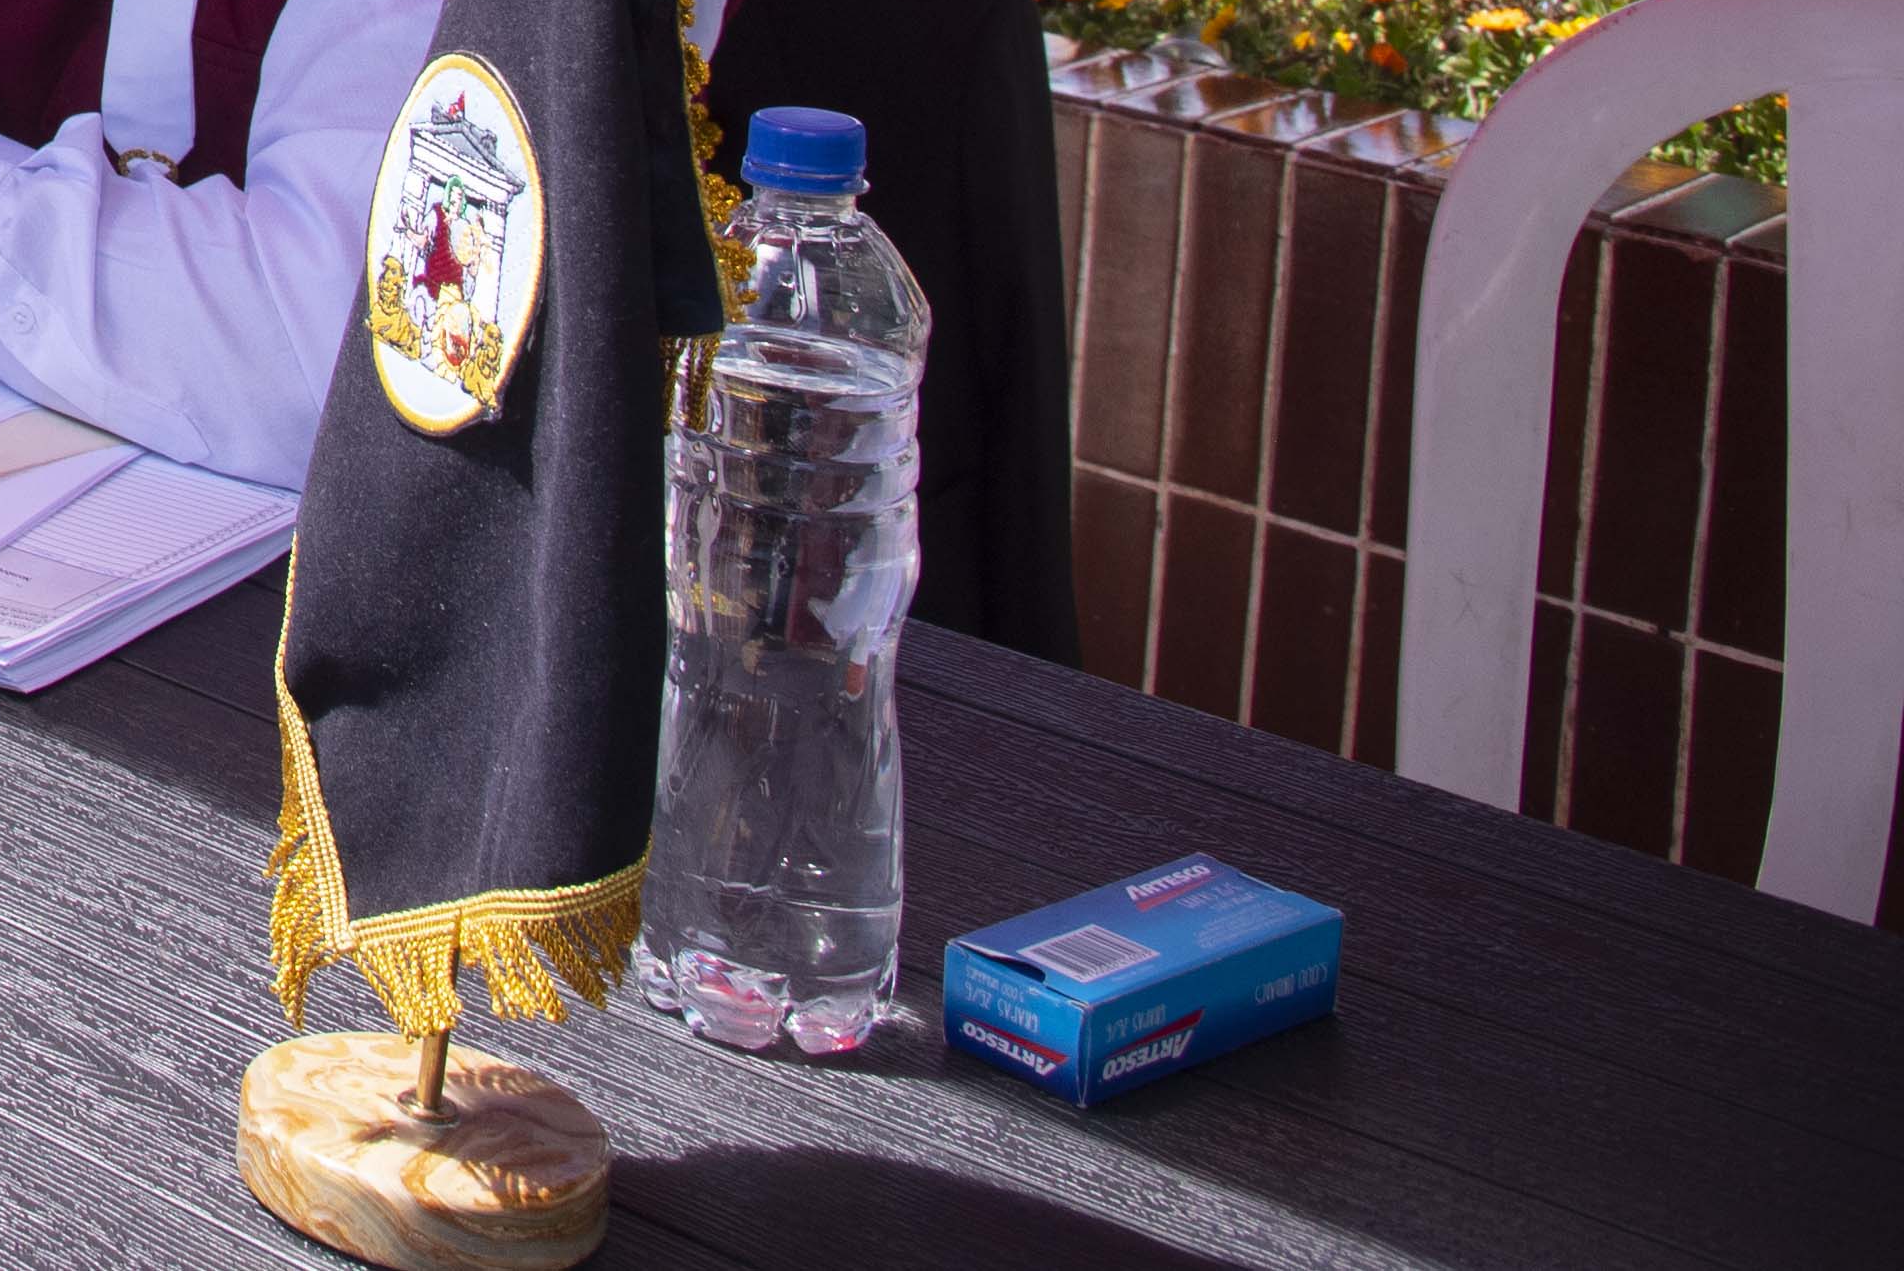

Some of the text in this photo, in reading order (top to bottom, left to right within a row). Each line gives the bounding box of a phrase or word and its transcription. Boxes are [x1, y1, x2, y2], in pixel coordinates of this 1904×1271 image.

[1125, 862, 1211, 902] ARTESCO
[963, 1021, 1056, 1076] ARTESCO
[1103, 1028, 1192, 1080] ARTESCO
